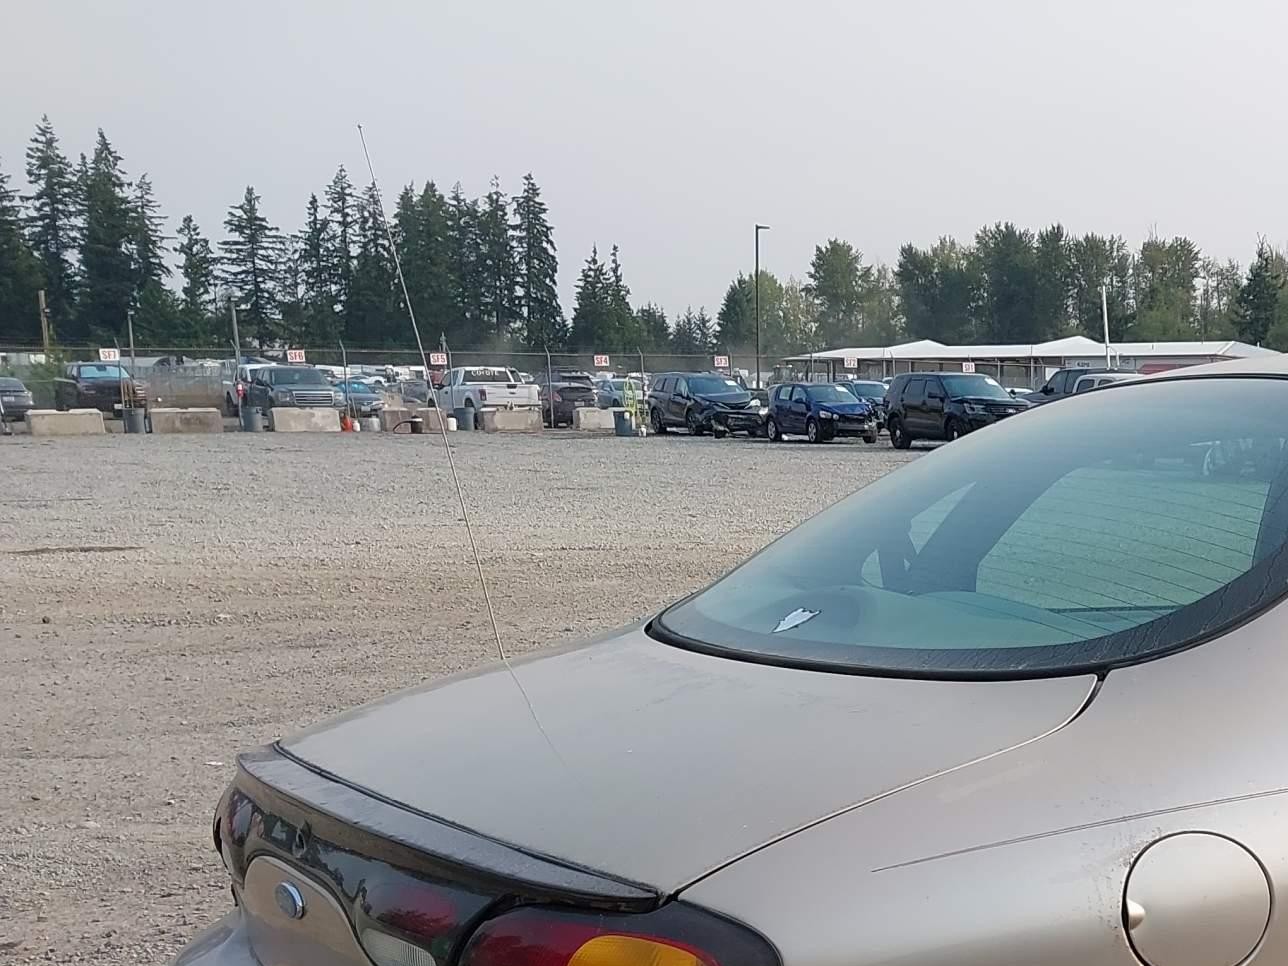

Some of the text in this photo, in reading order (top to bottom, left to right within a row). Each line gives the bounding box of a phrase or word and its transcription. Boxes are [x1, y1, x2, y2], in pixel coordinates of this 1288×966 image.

[102, 350, 116, 360] SF7
[289, 351, 303, 361] SF6
[431, 354, 446, 363] SF5
[595, 356, 609, 365] SF4
